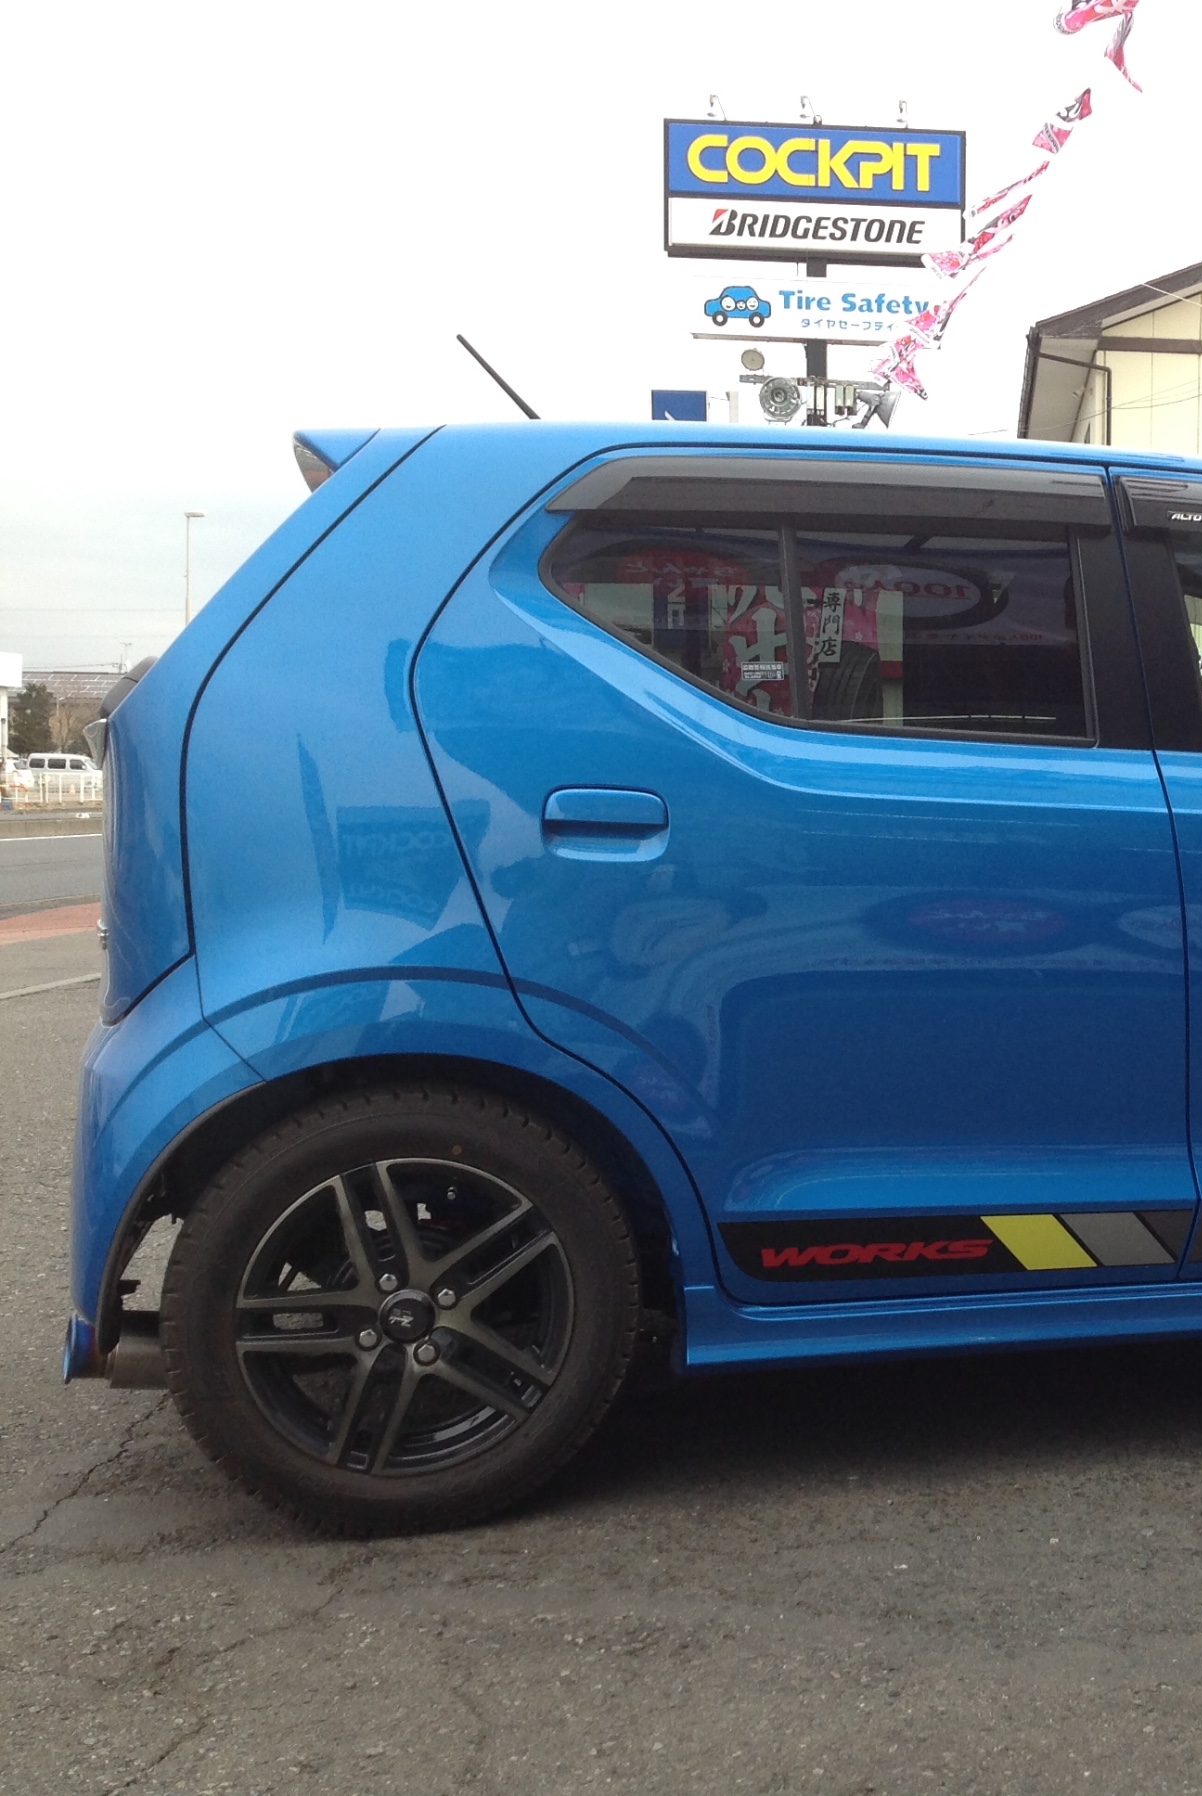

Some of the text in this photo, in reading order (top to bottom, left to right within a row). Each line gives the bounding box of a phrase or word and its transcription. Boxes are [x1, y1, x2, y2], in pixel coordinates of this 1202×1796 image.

[686, 134, 941, 191] COCKPIT
[709, 208, 925, 245] BRIDGESTONE
[779, 290, 929, 315] Tire Safety
[801, 318, 898, 332] タイヤセーフティ
[1171, 512, 1202, 522] ALTO
[819, 592, 841, 657] 専門店
[760, 1238, 993, 1268] WORKS
